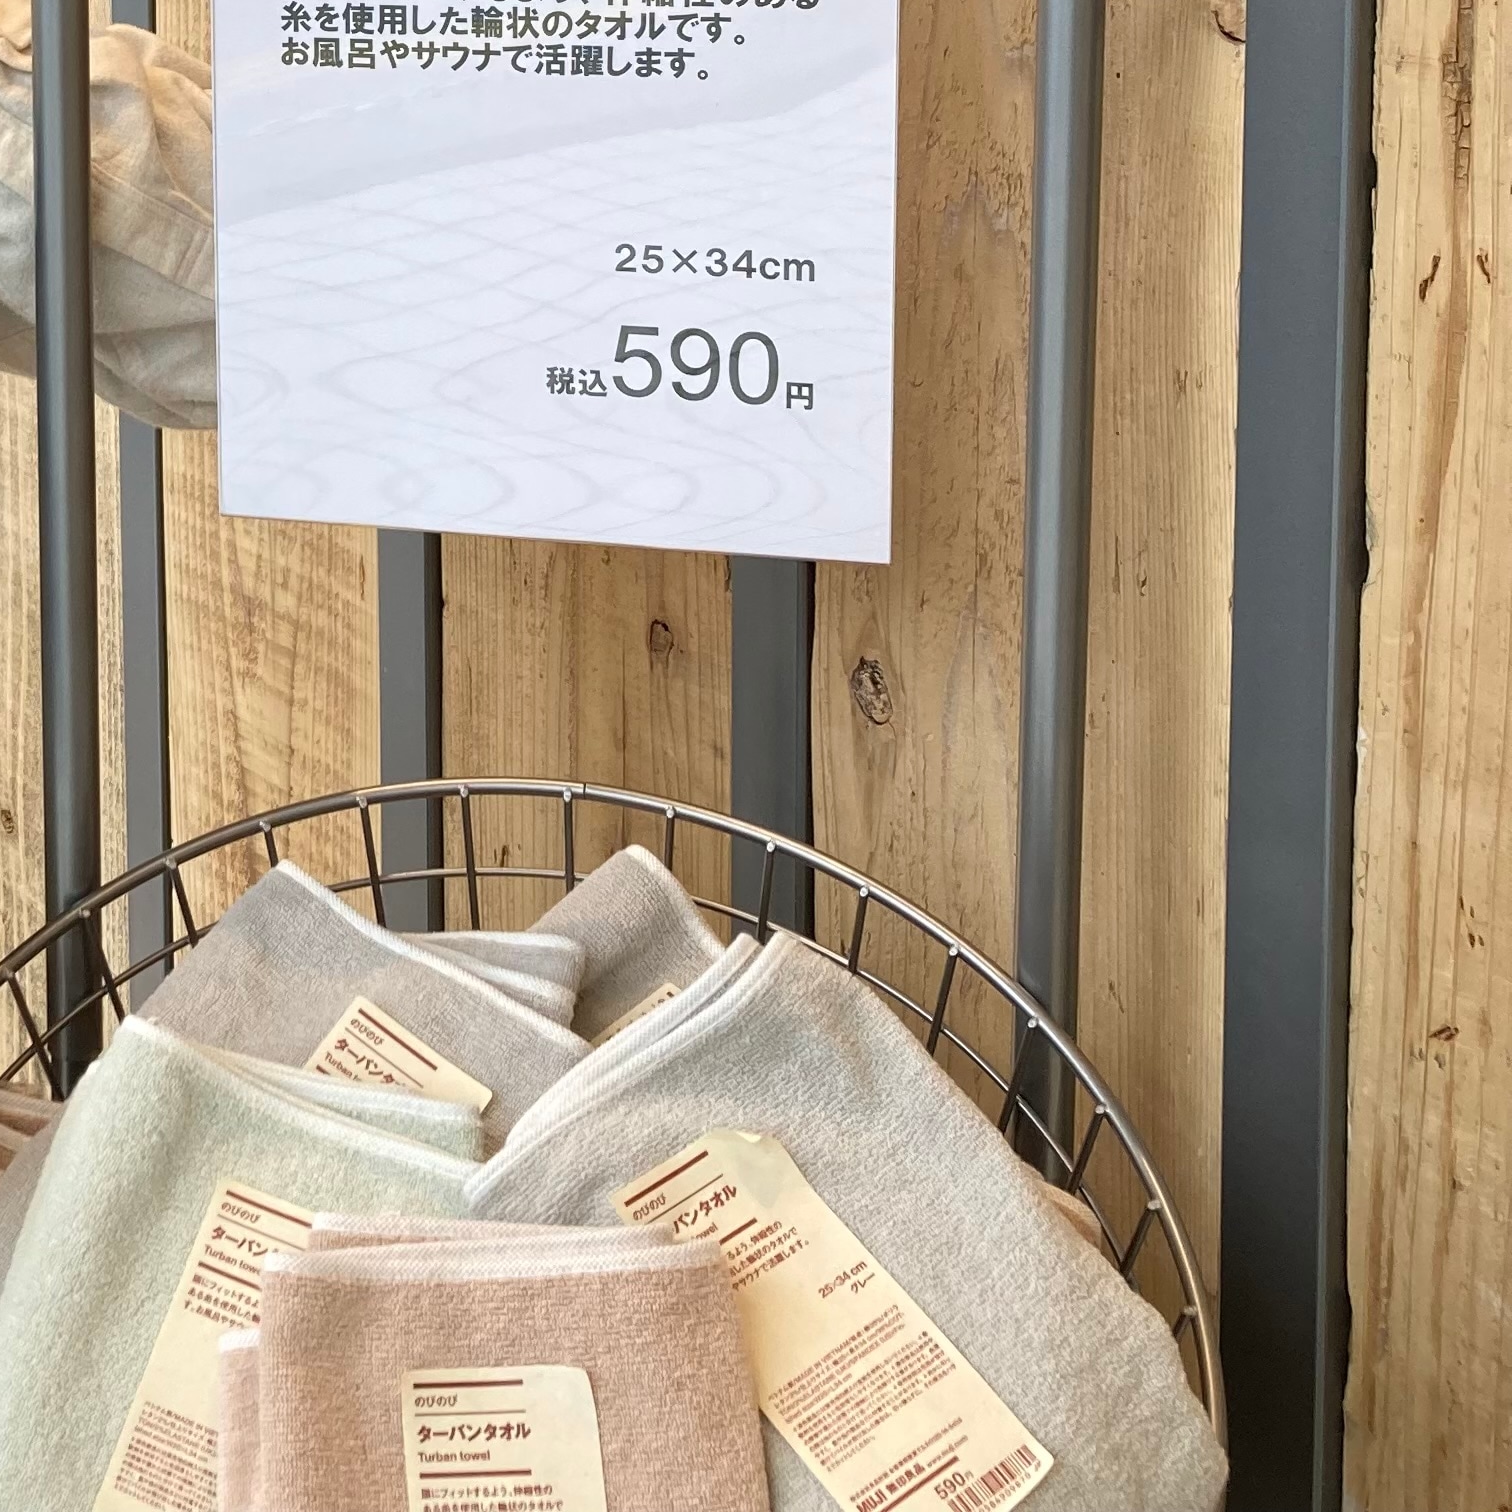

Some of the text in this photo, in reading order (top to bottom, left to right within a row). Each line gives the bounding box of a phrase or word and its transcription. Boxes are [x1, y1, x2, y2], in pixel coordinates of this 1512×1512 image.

[281, 2, 748, 45] 糸を使用した輪状のタオルです。
[281, 37, 709, 82] お風呂やサウナで活躍します。
[615, 244, 815, 282] 25×34cm
[350, 1017, 384, 1046] のびのび
[324, 1051, 353, 1080] Turban
[334, 1037, 406, 1088] ターバンタ
[221, 1201, 262, 1224] のびのび
[633, 1192, 667, 1221] のびのび
[203, 1244, 238, 1267] Turban
[211, 1225, 280, 1258] ターバン
[850, 1272, 875, 1295] グレー
[414, 1394, 458, 1408] のびのび
[417, 1422, 531, 1444] ターバンタオル
[418, 1449, 492, 1463] Turban towel
[934, 1469, 975, 1501] 590円
